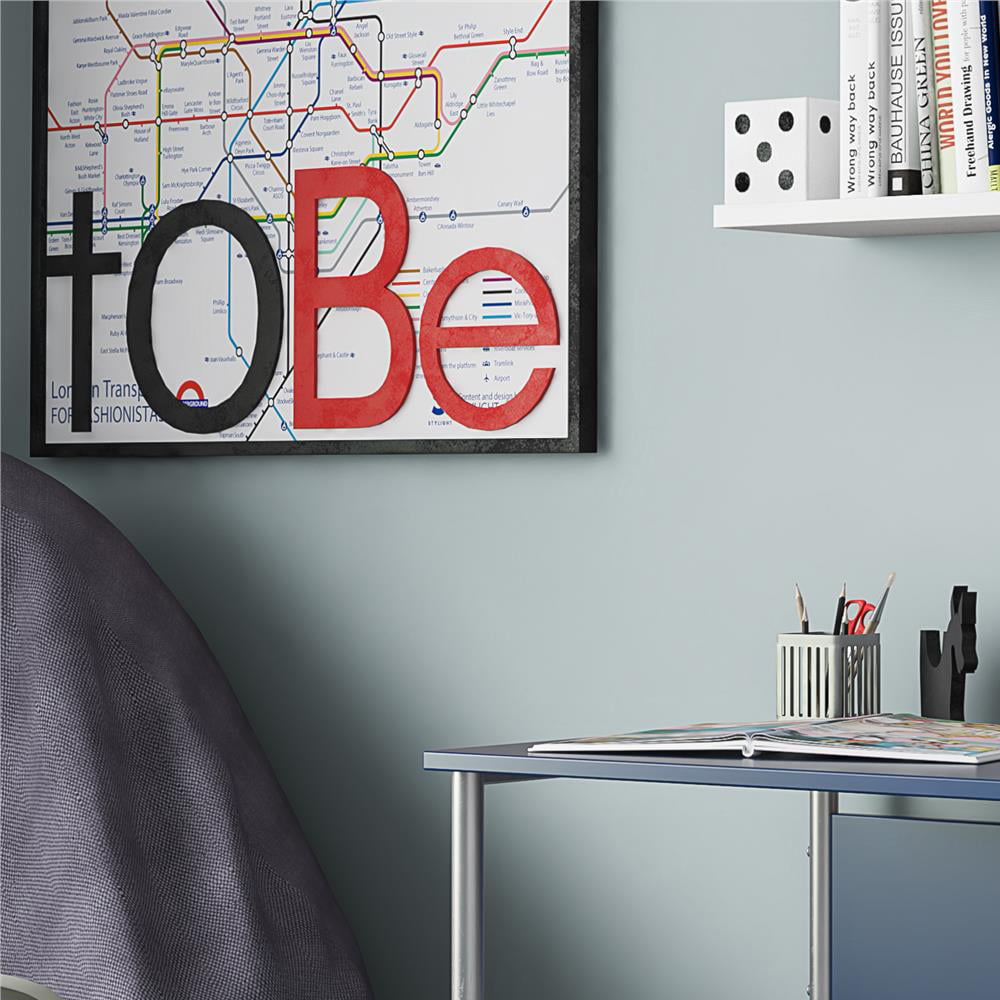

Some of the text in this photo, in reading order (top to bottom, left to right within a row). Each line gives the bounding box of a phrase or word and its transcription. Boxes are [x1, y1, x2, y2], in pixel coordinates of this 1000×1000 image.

[891, 0, 903, 164] BAUHAUSE ISSU
[962, 65, 972, 116] Drawing
[984, 69, 989, 78] In
[869, 104, 877, 134] way
[914, 37, 934, 188] CHINA GREEN
[987, 116, 996, 149] Alergic
[848, 149, 857, 193] Wrong
[868, 140, 877, 186] Wrong
[967, 120, 976, 177] Freehand
